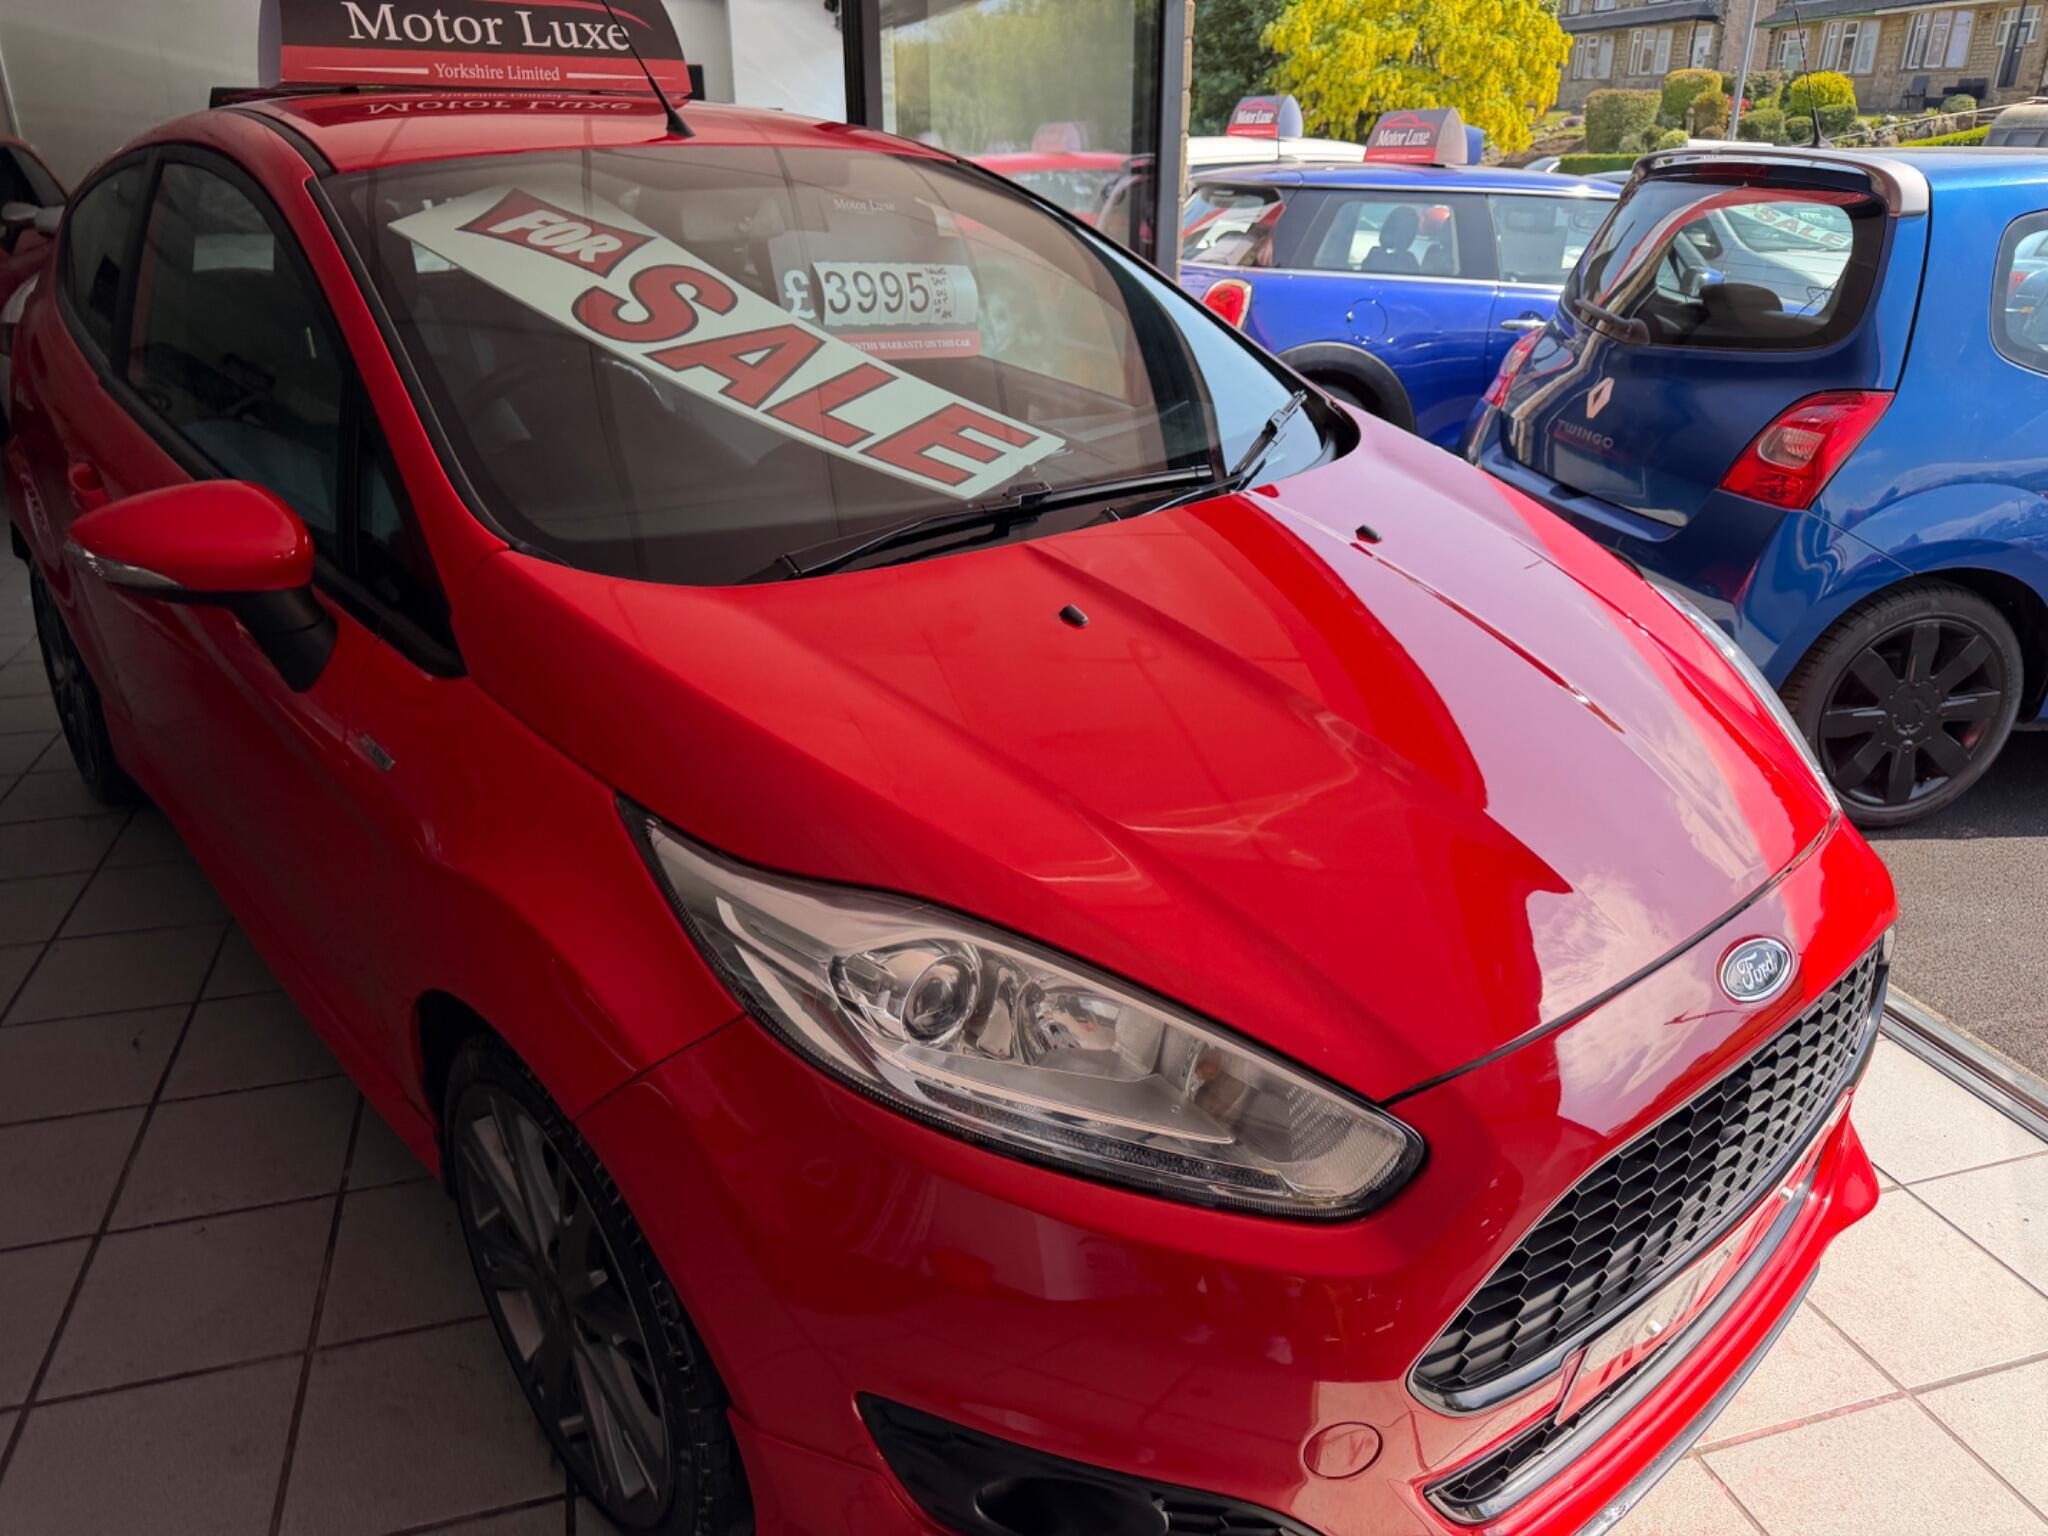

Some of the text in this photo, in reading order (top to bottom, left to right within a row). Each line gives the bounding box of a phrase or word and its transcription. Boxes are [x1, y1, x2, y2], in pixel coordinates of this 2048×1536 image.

[340, 1, 630, 51] Motor Luxe
[434, 63, 560, 81] Yorkshire Limited
[1376, 128, 1430, 146] Motor Luxe
[487, 208, 623, 263] FOR
[572, 264, 1041, 487] SALE
[1556, 418, 1614, 449] TWINGO
[1736, 951, 1777, 990] Ford
